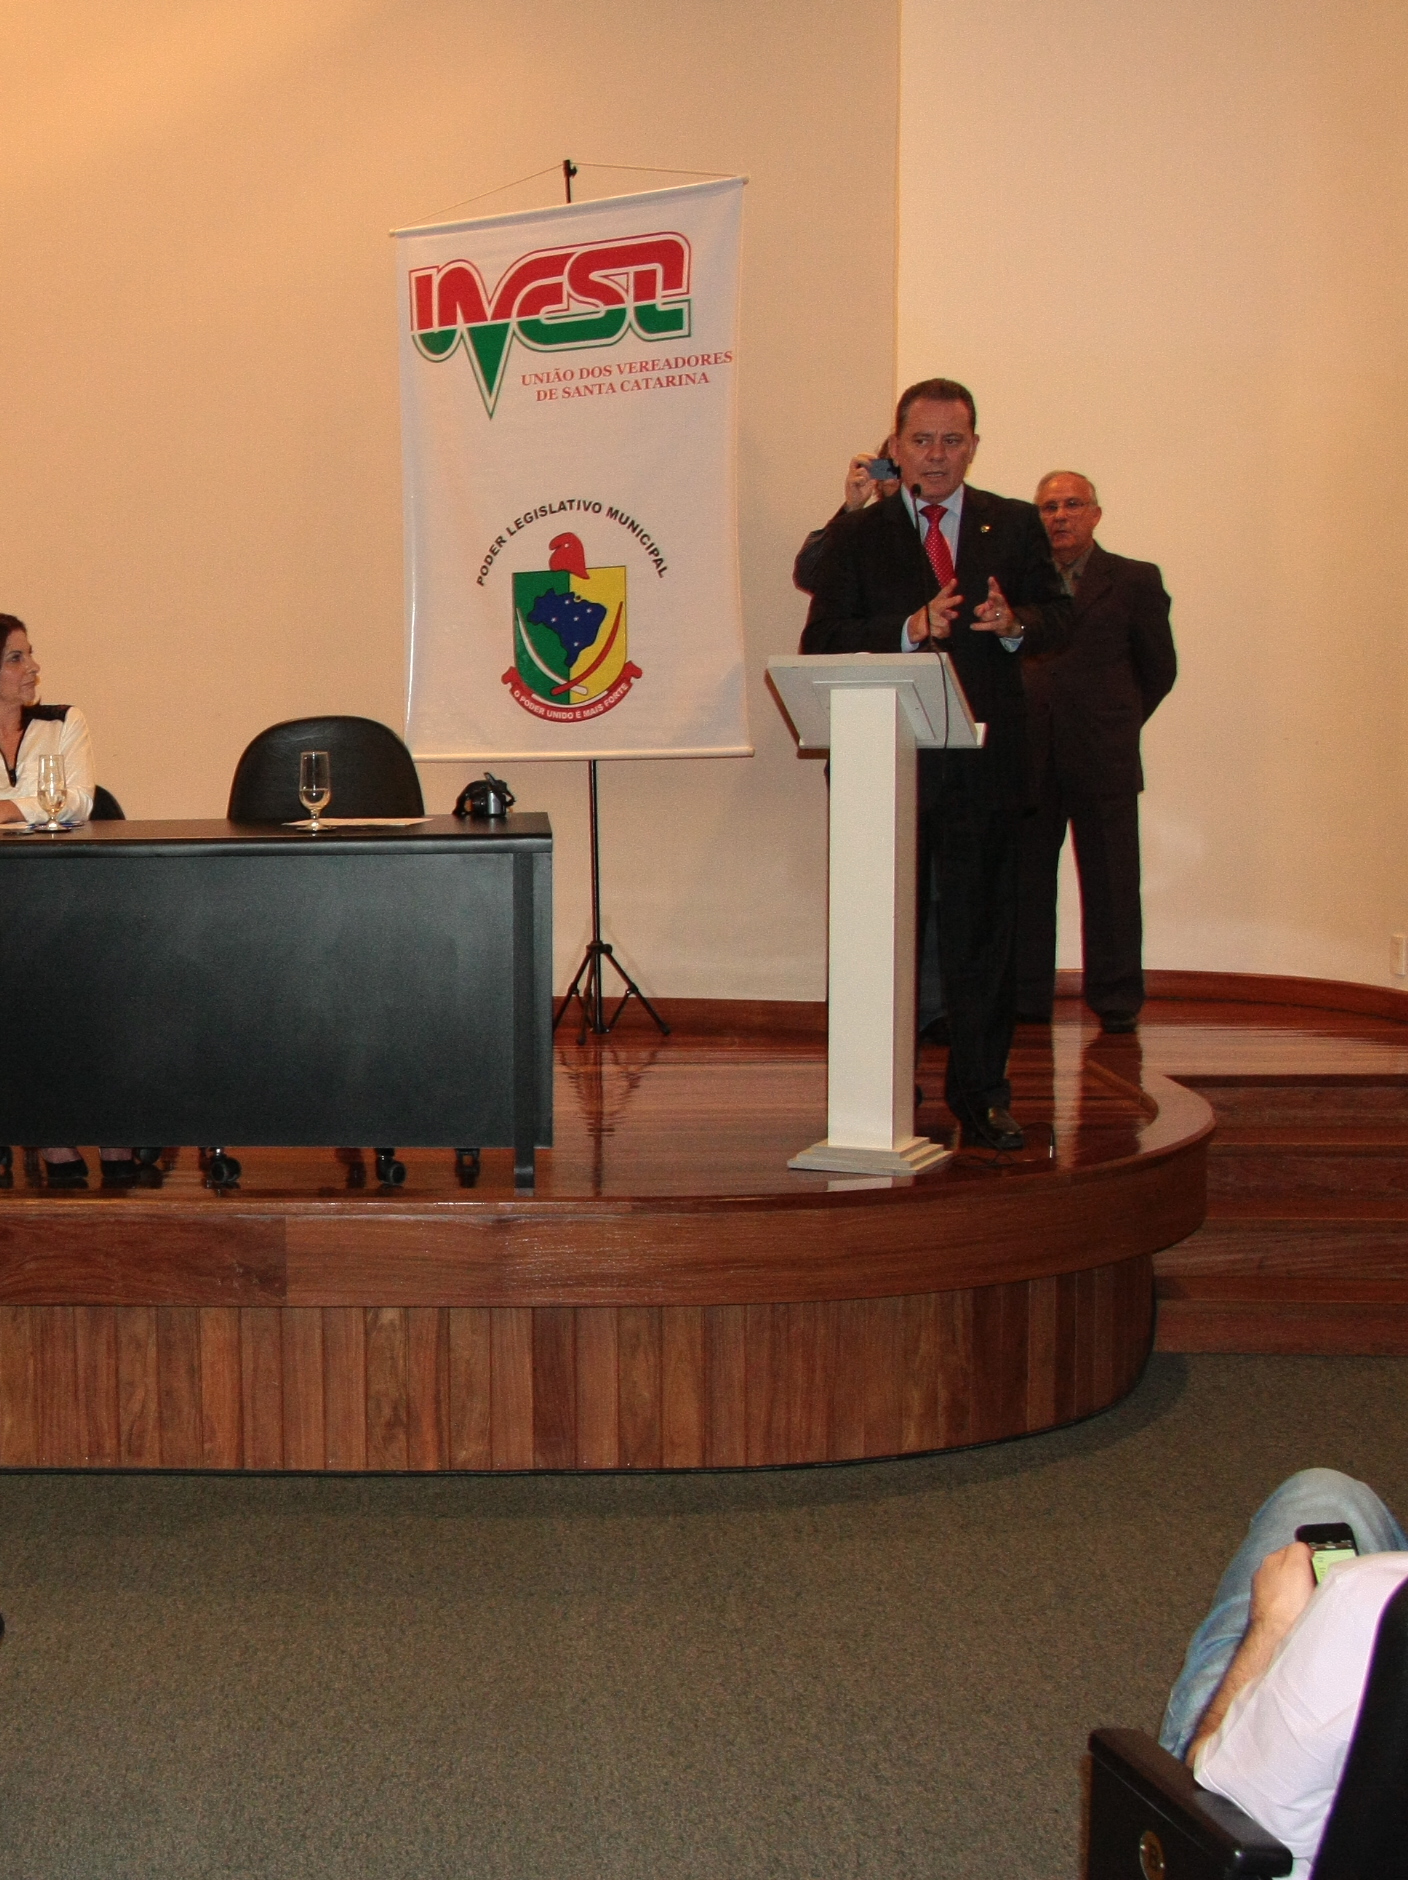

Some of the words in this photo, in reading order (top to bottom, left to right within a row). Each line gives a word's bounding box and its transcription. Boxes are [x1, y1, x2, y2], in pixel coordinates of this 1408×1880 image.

[521, 367, 574, 386] UNIÃO
[579, 364, 612, 380] DOS
[616, 350, 733, 375] VEREADORES
[536, 388, 558, 401] DE
[561, 381, 616, 399] SANTA
[620, 372, 710, 392] CATARINA
[476, 535, 507, 587] PODER
[506, 499, 602, 537] LEGISLATIVO
[605, 506, 668, 579] MUNICIPAL
[513, 690, 519, 698] O
[519, 697, 545, 715] PODER
[546, 709, 573, 719] UNIDO
[583, 704, 604, 717] MAIS
[604, 682, 629, 706] FORTE
